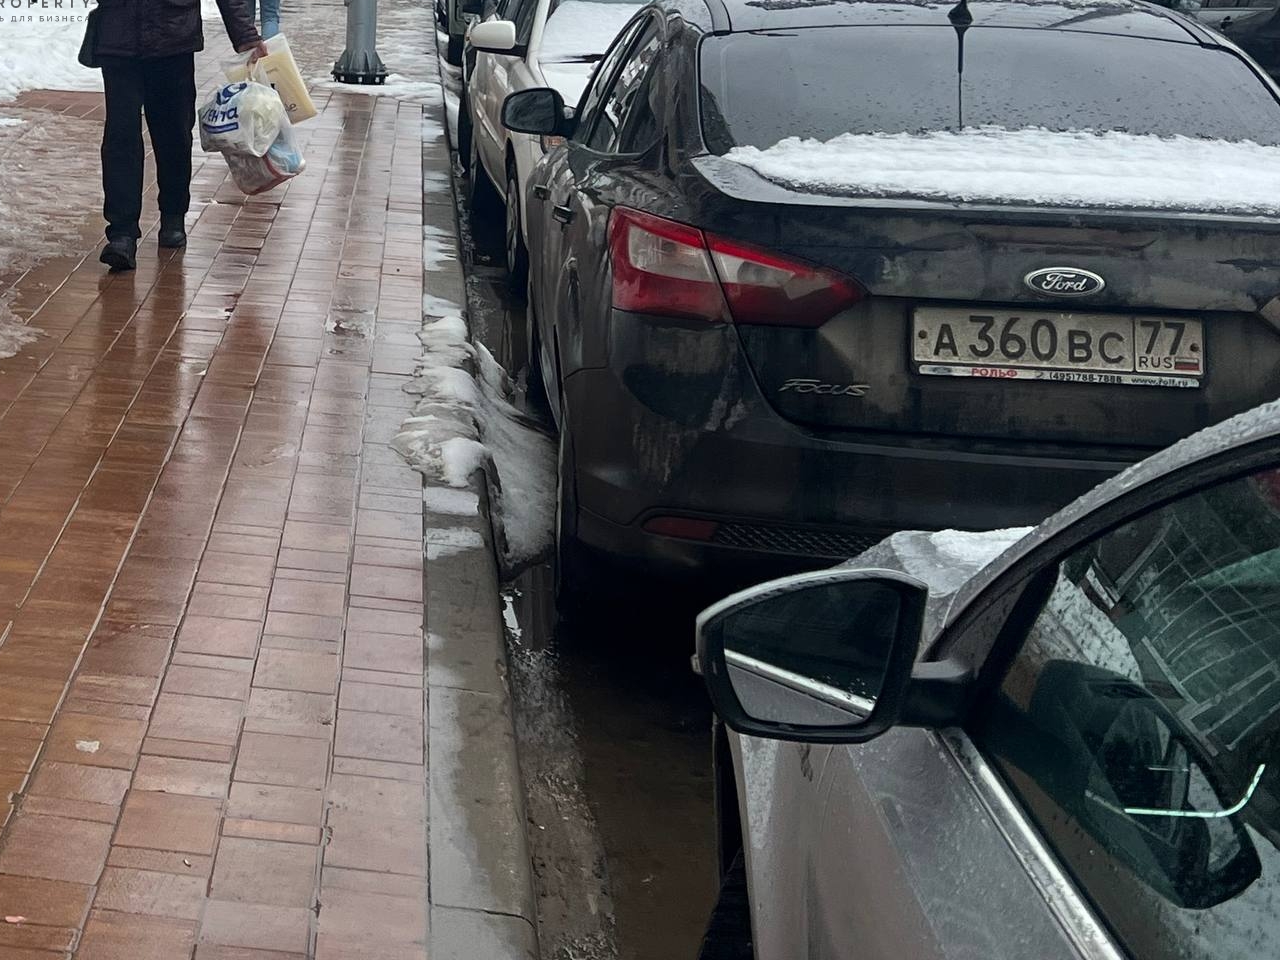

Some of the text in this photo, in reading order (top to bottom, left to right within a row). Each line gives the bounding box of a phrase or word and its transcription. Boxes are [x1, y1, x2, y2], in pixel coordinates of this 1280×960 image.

[1041, 272, 1088, 291] Ford
[1140, 320, 1186, 355] 77
[1139, 356, 1173, 369] RUS
[971, 368, 1018, 378] РОЛЬФ
